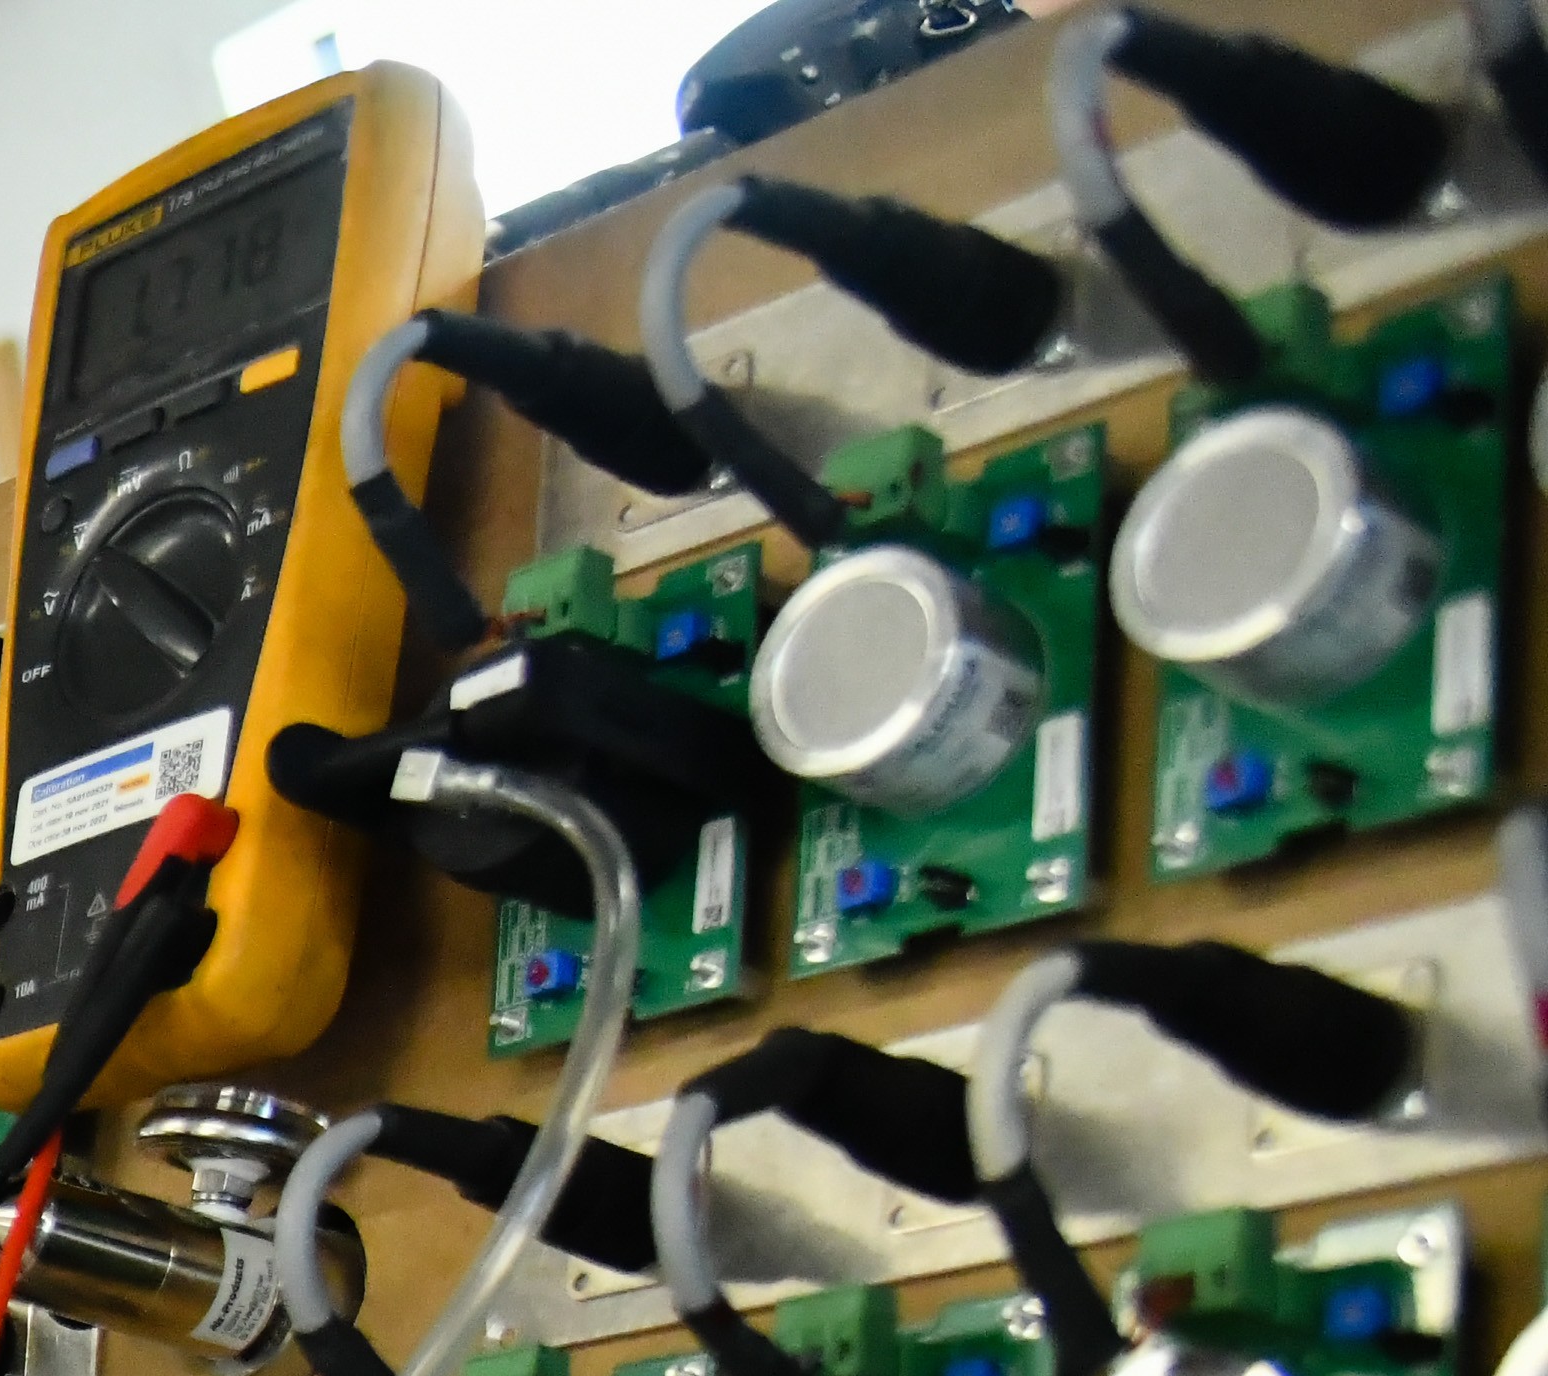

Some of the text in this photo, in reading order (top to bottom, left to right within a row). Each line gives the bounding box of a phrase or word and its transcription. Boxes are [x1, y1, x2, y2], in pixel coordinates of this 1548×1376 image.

[21, 663, 53, 684] OFF
[26, 874, 49, 895] 400
[26, 893, 46, 912] mA
[14, 979, 36, 999] 10A
